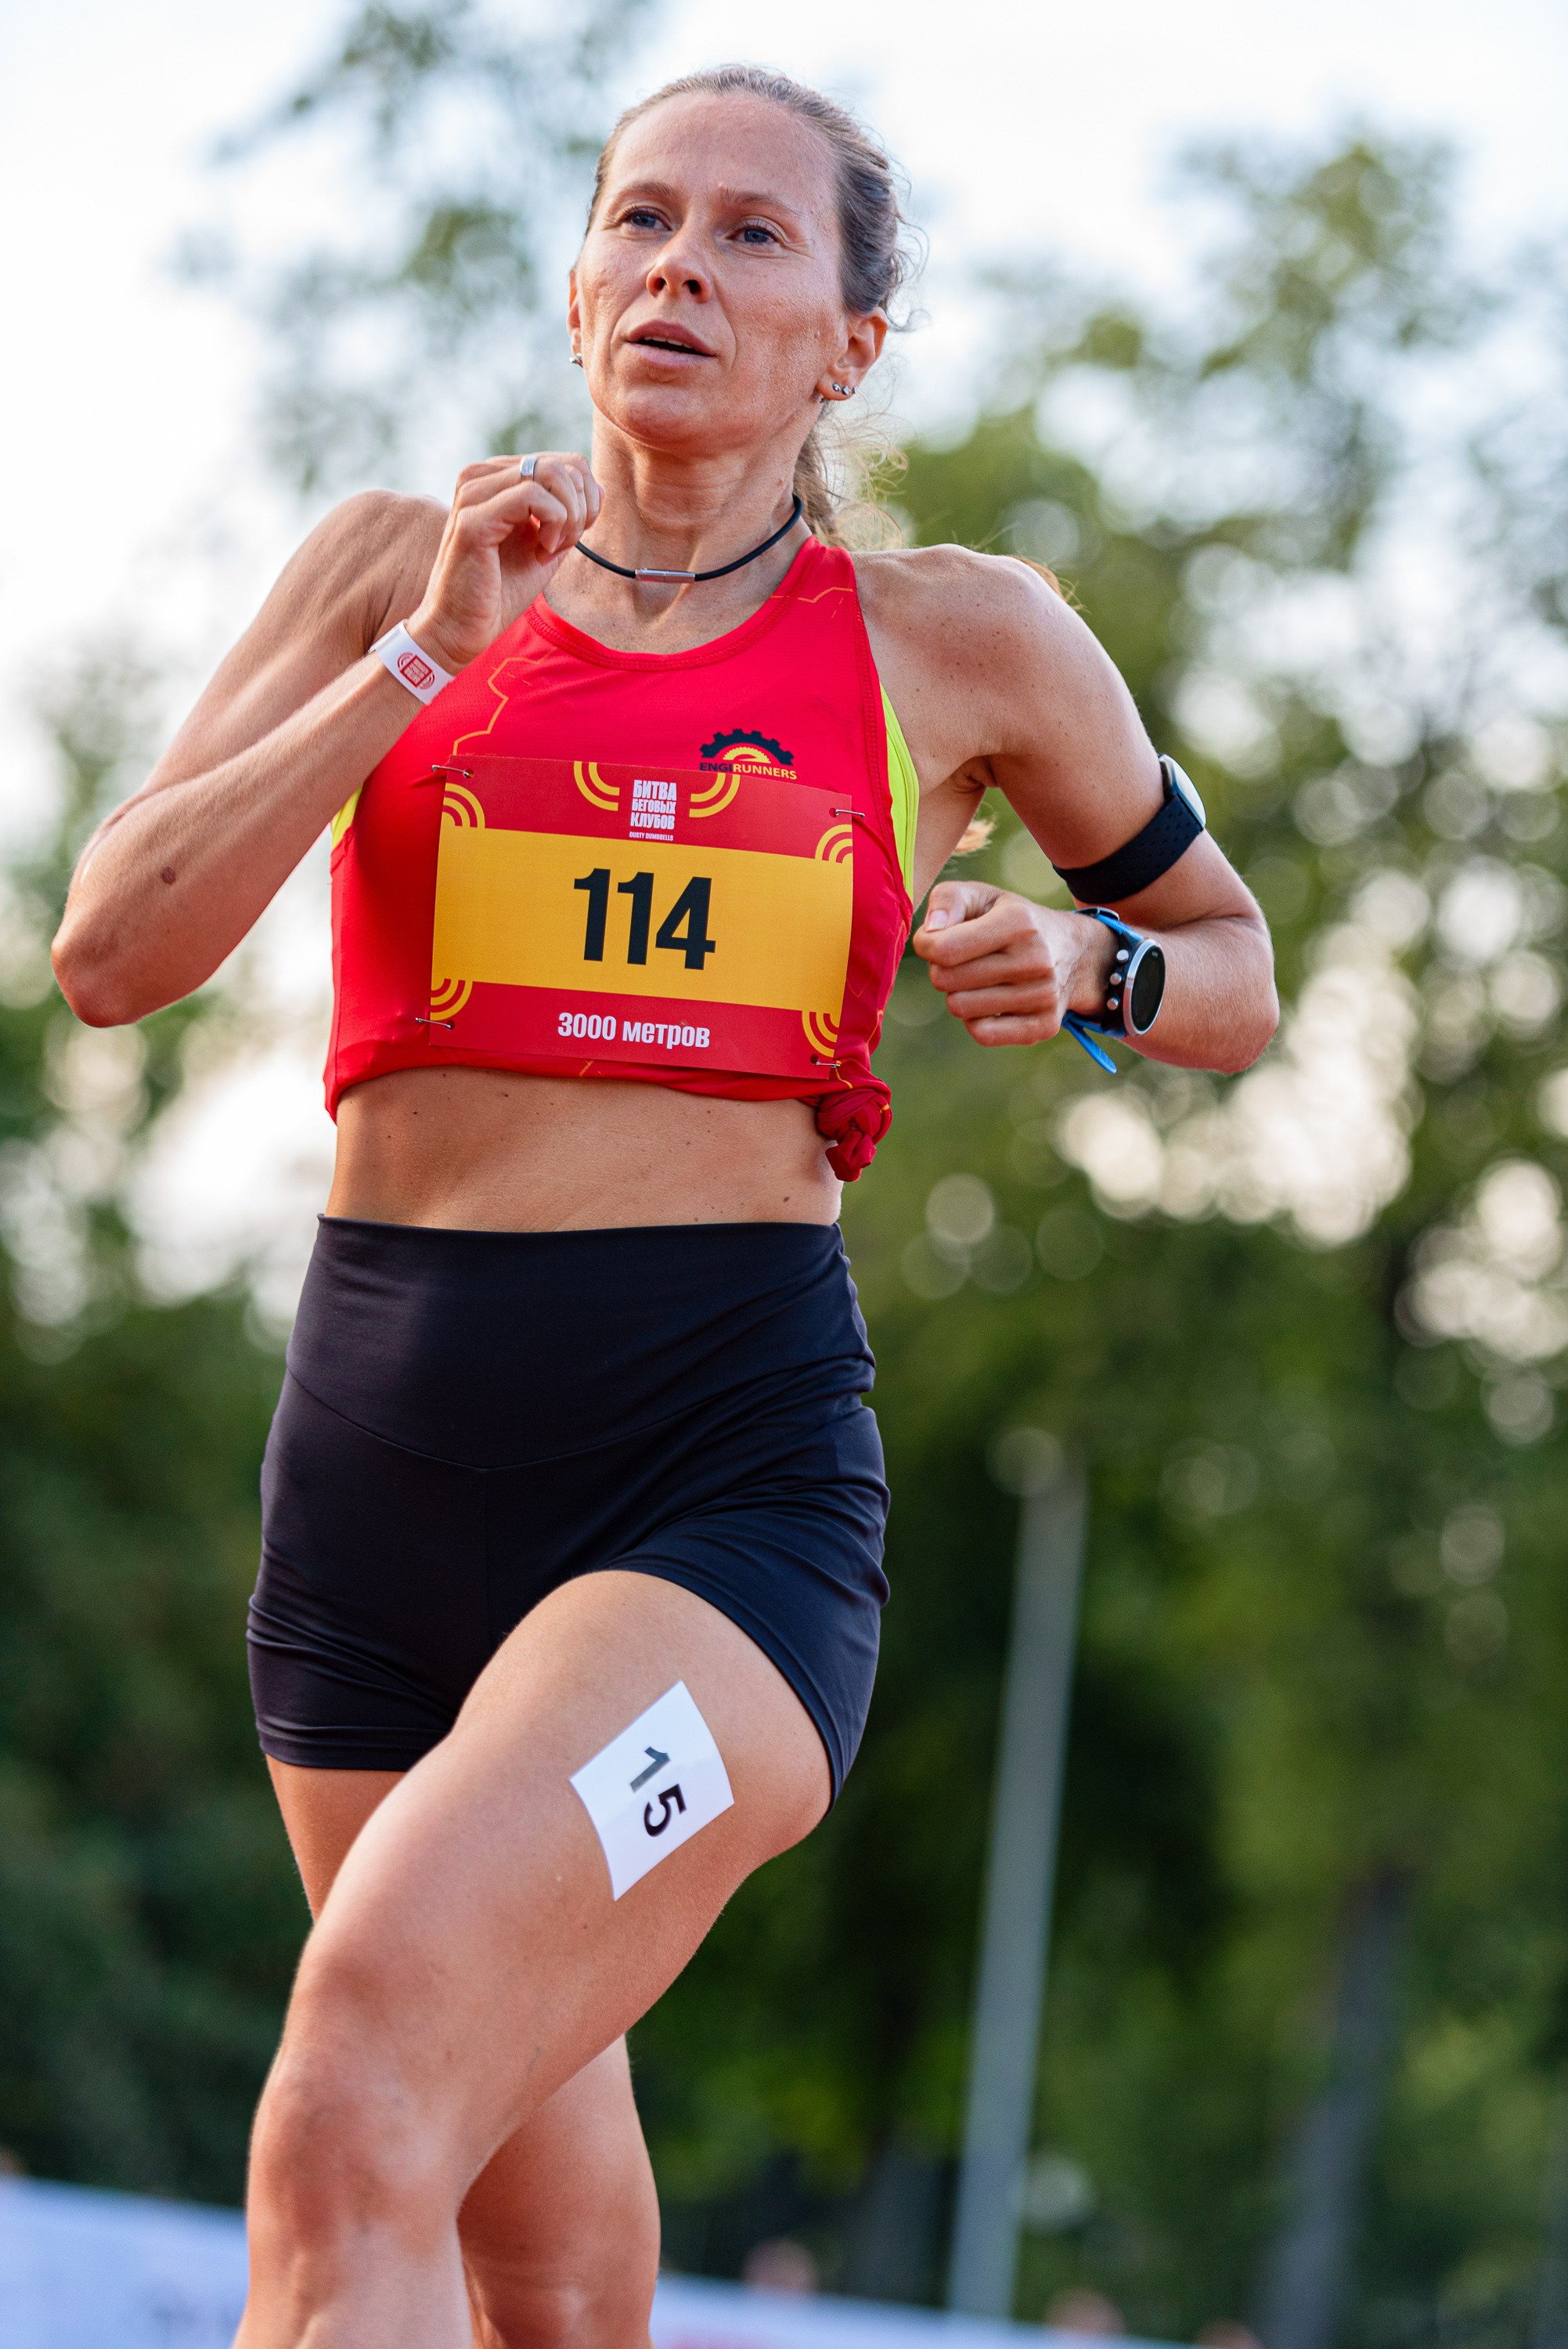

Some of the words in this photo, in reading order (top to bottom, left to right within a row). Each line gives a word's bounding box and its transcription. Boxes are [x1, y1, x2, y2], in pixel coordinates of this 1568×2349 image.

[700, 762, 797, 781] ENGIRUNNERS
[633, 779, 676, 801] БИТВА
[632, 799, 676, 814] БЕГОВЫХ
[630, 812, 676, 829] КЛУБОВ
[629, 831, 645, 839] DUSTY
[645, 832, 674, 841] DUMBBELLS
[574, 868, 716, 970] 114
[557, 1012, 617, 1041] 3000
[622, 1020, 711, 1050] метров
[629, 1746, 687, 1837] 15
